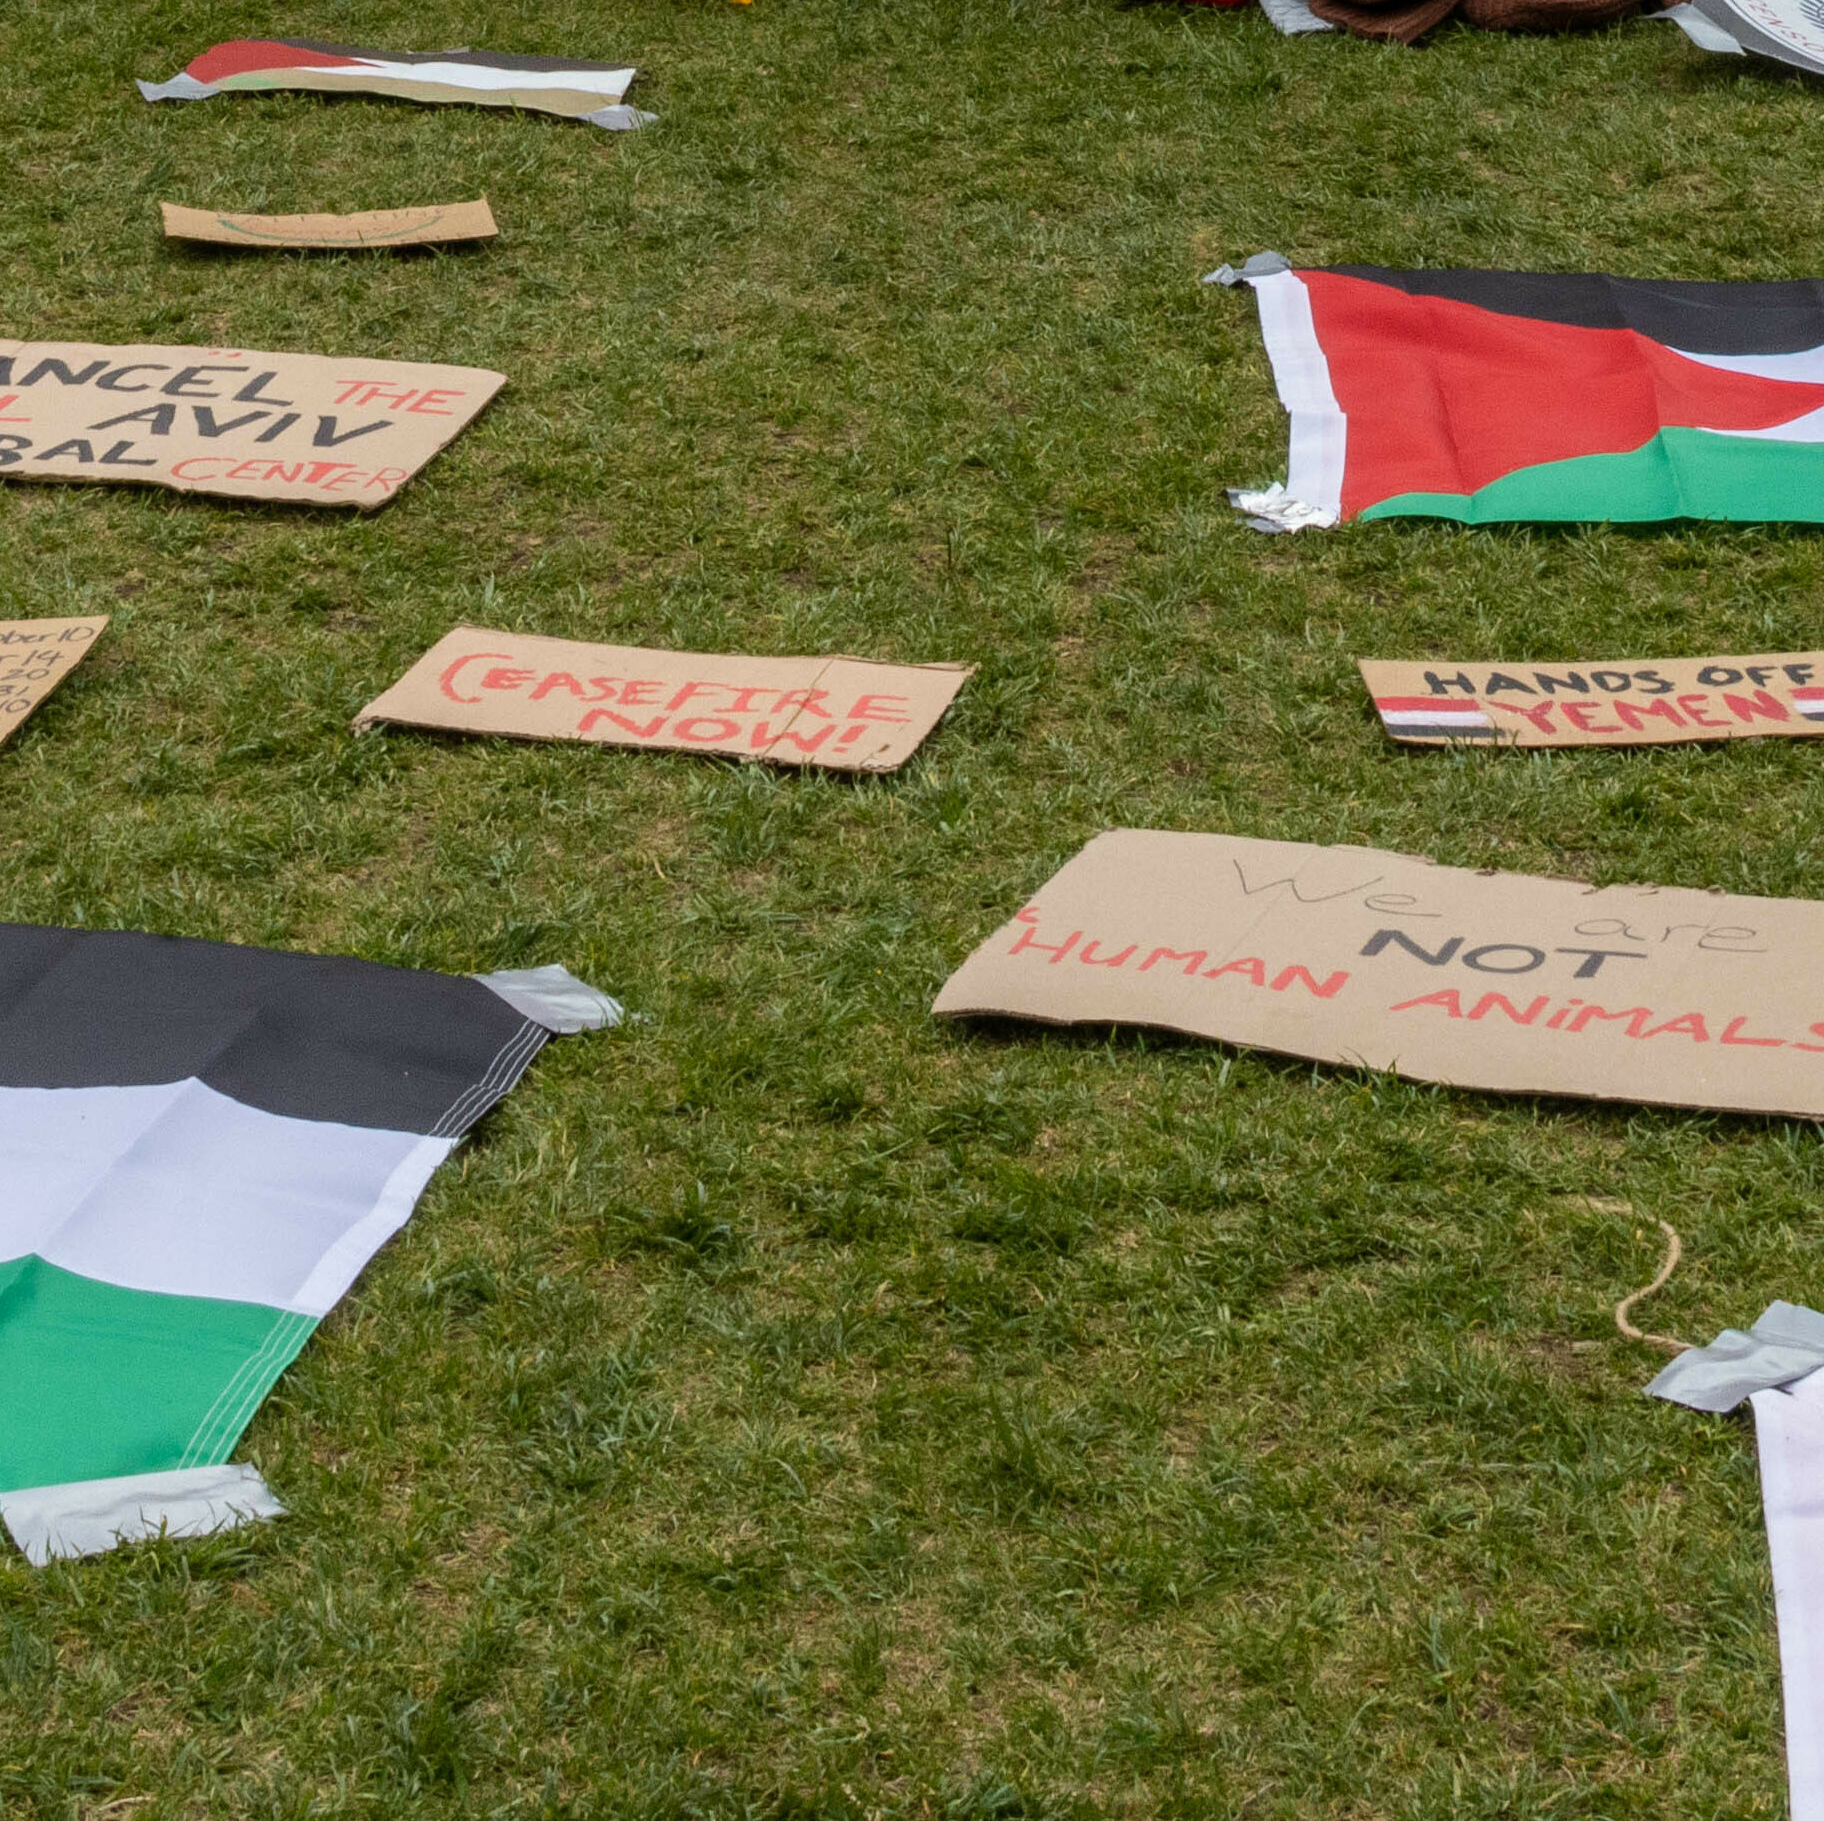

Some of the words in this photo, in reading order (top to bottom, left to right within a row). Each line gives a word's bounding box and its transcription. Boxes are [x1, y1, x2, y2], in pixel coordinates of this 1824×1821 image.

[332, 377, 467, 417] THE
[86, 400, 397, 449] AVIV
[169, 455, 409, 495] CENTER
[56, 625, 96, 643] 10
[0, 667, 51, 681] 20
[21, 650, 65, 666] 14
[1420, 669, 1677, 696] HANDS
[1695, 662, 1817, 688] OFF
[438, 652, 914, 724] CEASEFIRE
[576, 707, 870, 754] NOW!
[1484, 688, 1793, 736] YEMEN
[1229, 857, 1446, 920] We
[1572, 913, 1771, 958] are
[1356, 927, 1649, 983] NOT
